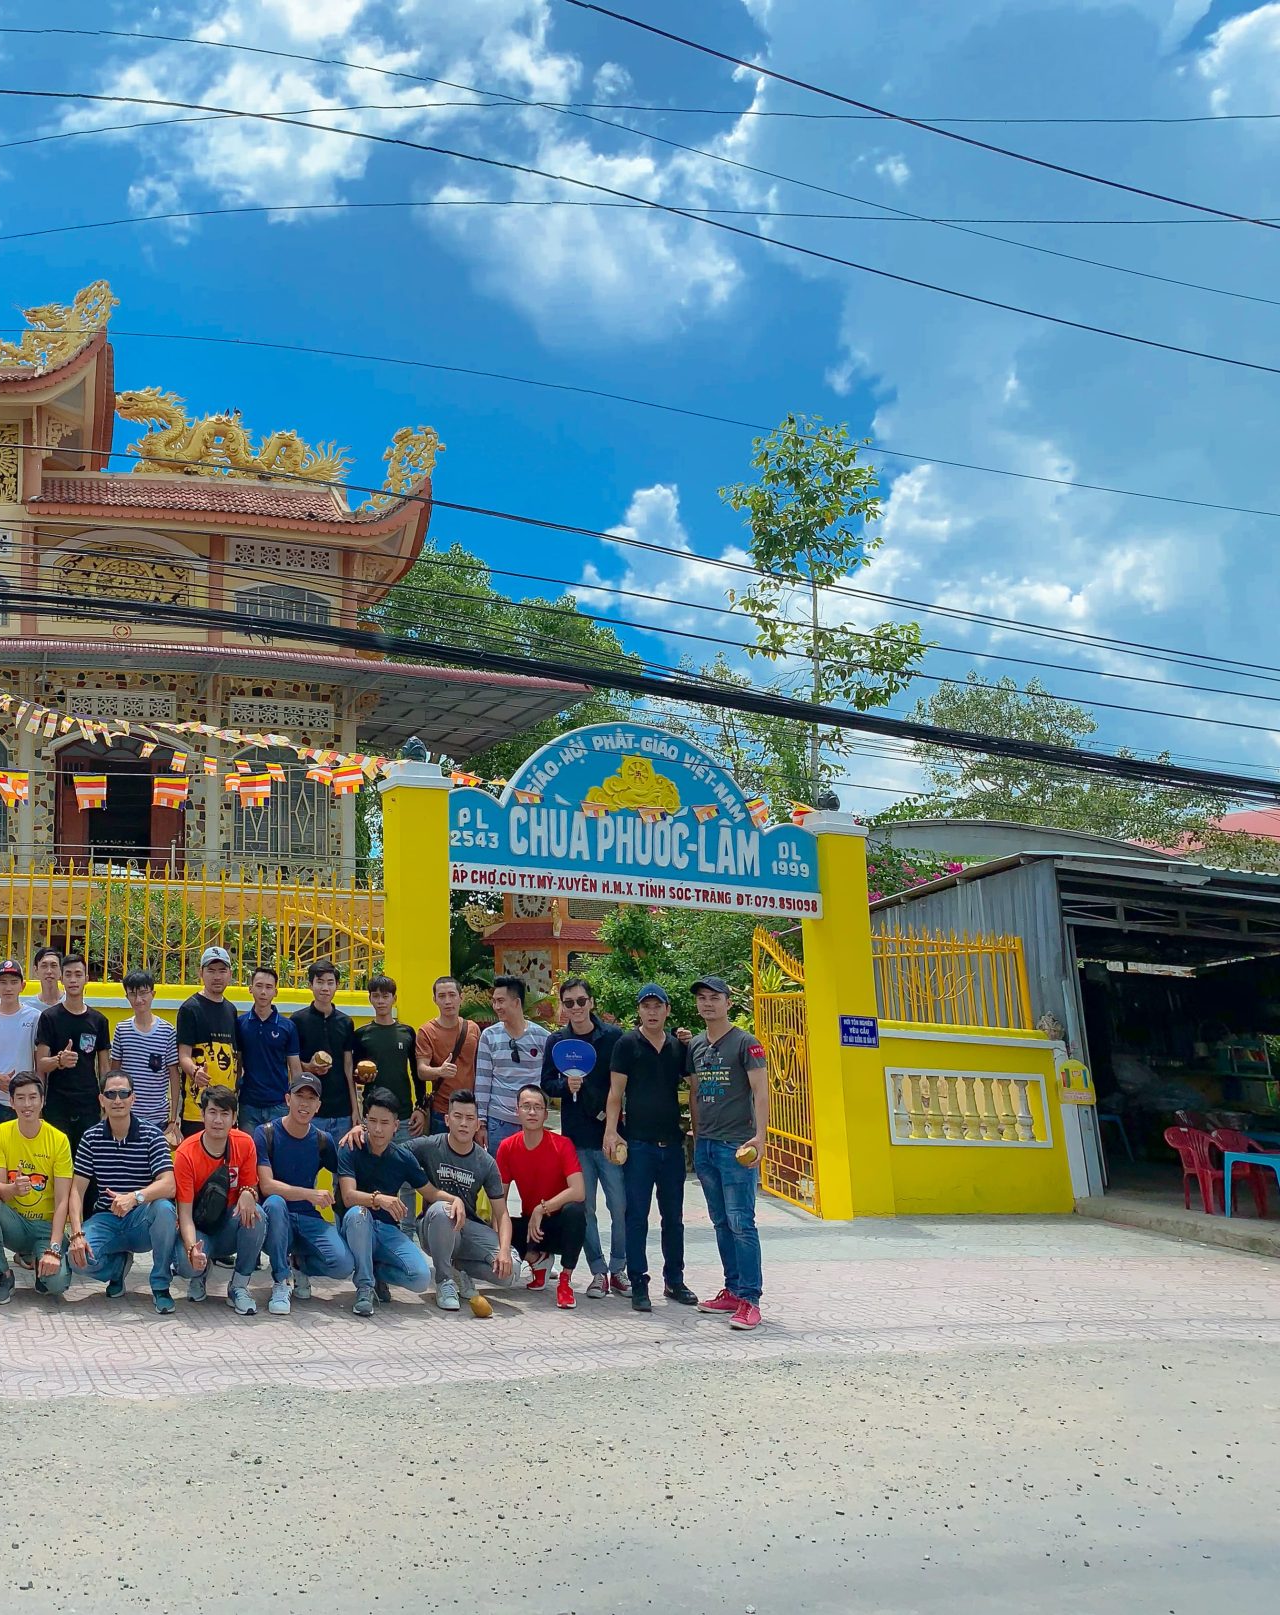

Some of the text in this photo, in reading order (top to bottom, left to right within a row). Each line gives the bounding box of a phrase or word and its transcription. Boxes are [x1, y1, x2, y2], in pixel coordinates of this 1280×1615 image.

[449, 829, 499, 849] 2543
[778, 841, 802, 861] DL
[452, 863, 469, 883] ẤP
[771, 860, 810, 878] 1999
[702, 1095, 715, 1103] LIFE
